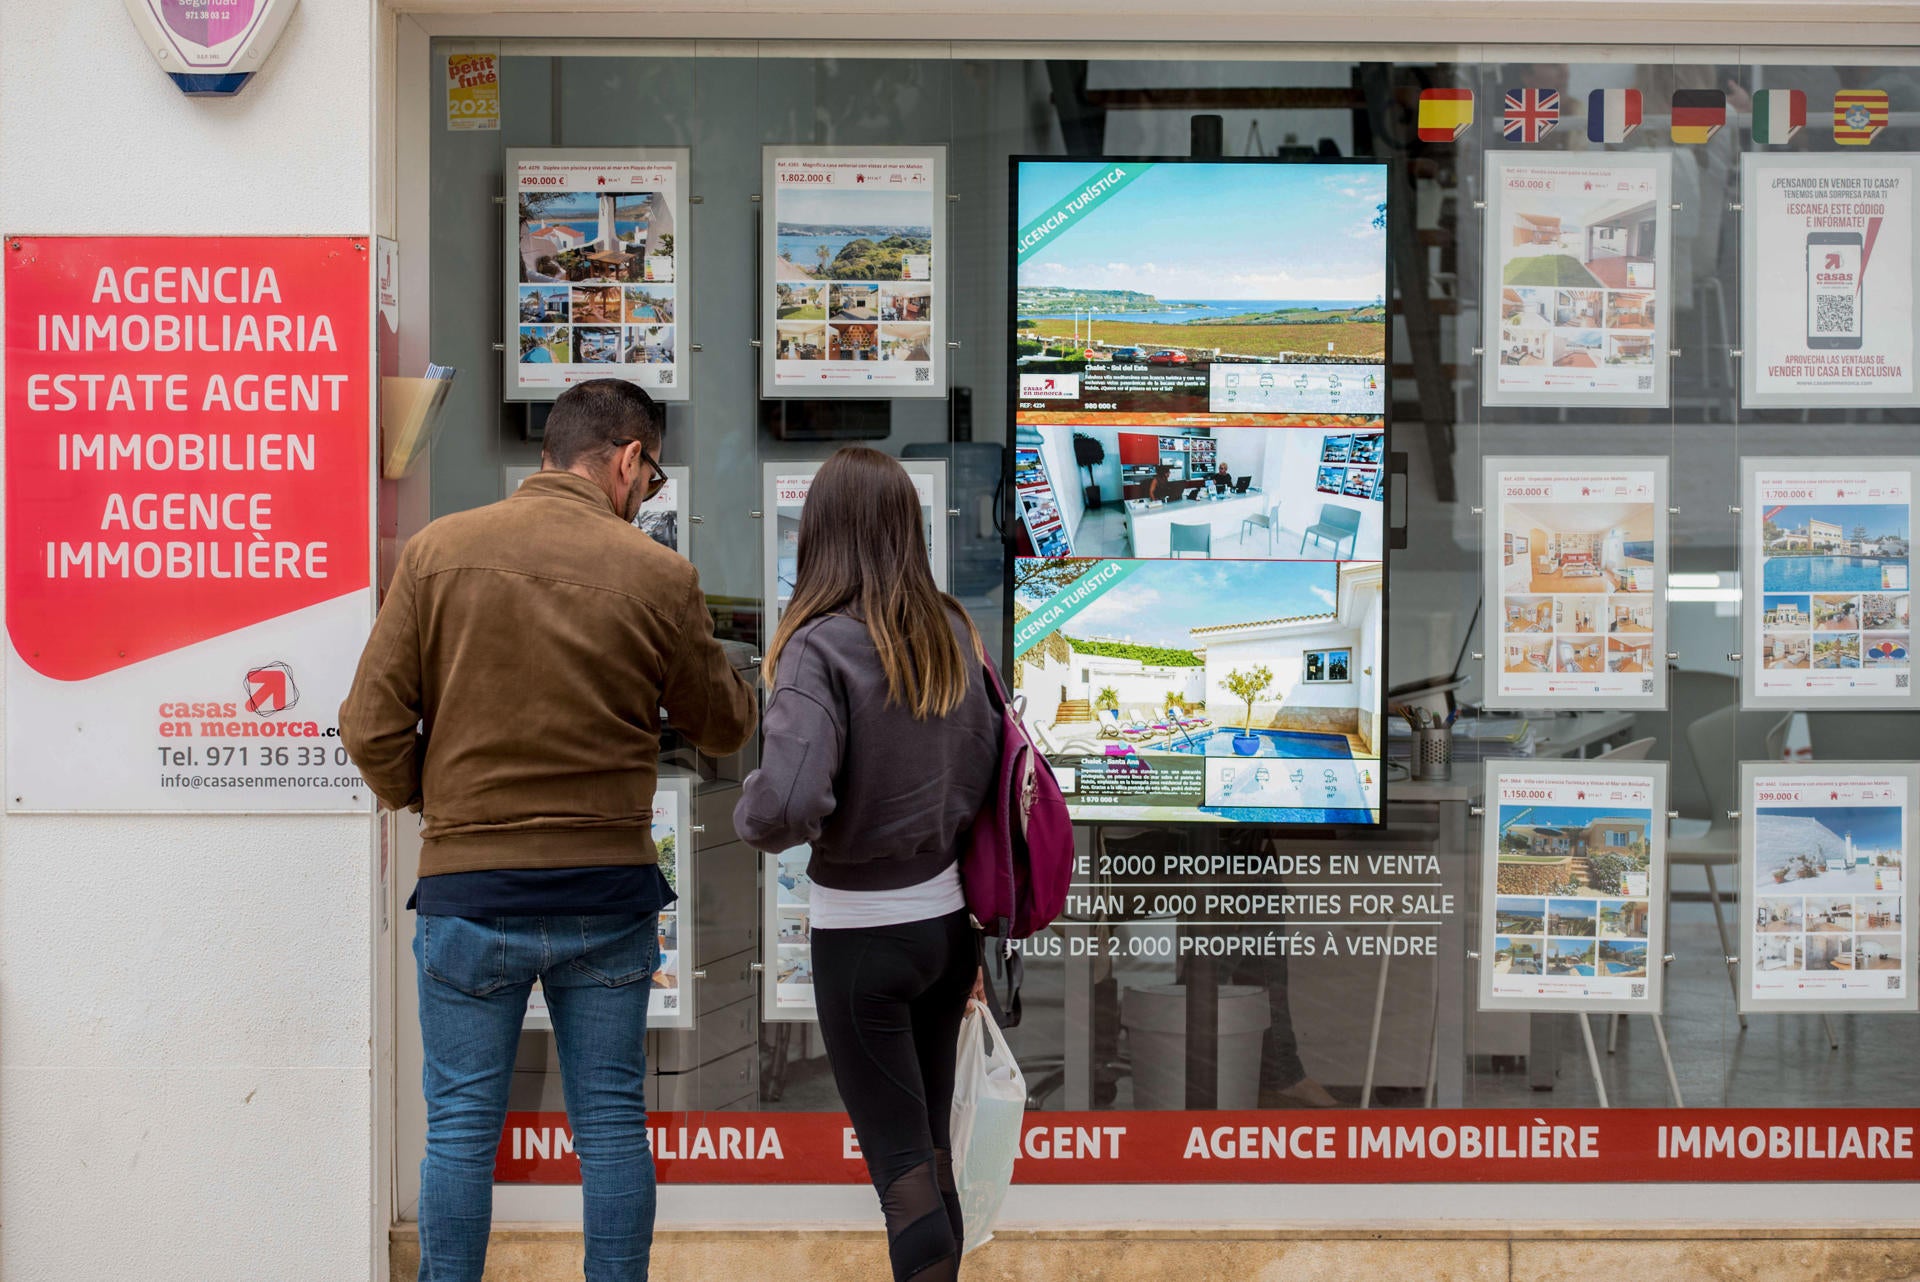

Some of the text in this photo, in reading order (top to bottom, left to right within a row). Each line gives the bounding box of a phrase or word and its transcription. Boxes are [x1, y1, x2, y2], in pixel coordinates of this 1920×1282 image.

[448, 56, 494, 80] petit
[458, 70, 496, 88] futé
[450, 99, 498, 114] 2023
[521, 176, 564, 185] 490.000 €
[780, 174, 832, 183] 1.802.000 €
[1508, 180, 1552, 190] 450.000 €
[1771, 178, 1900, 189] ¿PENSANDO EN VENDER TU CASA?
[1066, 168, 1126, 214] TURÍSTICA
[1784, 190, 1814, 199] TENEMOS
[1815, 190, 1828, 199] UNA
[1829, 190, 1862, 199] SORPRESA
[1863, 190, 1880, 199] PARA
[1786, 202, 1885, 215] ¡ESCANEA ESTE CÓDIGO
[1806, 216, 1865, 228] E INFÓRMATE!
[1816, 272, 1853, 281] casas
[92, 267, 282, 303] AGENCIA
[38, 315, 338, 352] INMOBILIARIA
[1785, 355, 1885, 364] APROVECHA LAS VENTAJAS DE
[1768, 366, 1902, 377] VENDER TU CASA EN EXCLUSIVA
[27, 374, 349, 412] ESTATE AGENT
[58, 434, 315, 471] IMMOBILIEN
[780, 491, 808, 499] 120.00
[1506, 488, 1549, 496] 260.000 €
[1766, 490, 1813, 498] 1.700.000 €
[100, 494, 272, 530] AGENCE
[46, 532, 328, 578] IMMOBILIÈRE
[1062, 562, 1122, 608] TURÍSTICA
[159, 702, 237, 718] casas
[159, 721, 340, 738] en menorca.c
[158, 746, 198, 766] Tel.
[207, 746, 248, 766] 971
[260, 746, 289, 766] 36
[298, 746, 326, 766] 33
[161, 774, 364, 788] info@casasenmenorca.com
[1503, 790, 1552, 798] 1.150.000 €
[1759, 792, 1799, 800] 399.000 €
[1100, 855, 1156, 876] 2000
[1164, 855, 1321, 876] PROPIEDADES
[1330, 855, 1359, 876] EN
[1367, 855, 1440, 876] VENTA
[1066, 895, 1454, 915] THAN 2.000 PROPERTIES FOR SALE
[1006, 931, 1438, 956] PLUS DE 2.000 PROPRIÉTÉS À VENDRE
[1014, 1126, 1126, 1159] GENT
[1183, 1118, 1599, 1159] AGENCE IMMOBILIÈRE
[1658, 1126, 1914, 1158] IMMOBILIARE
